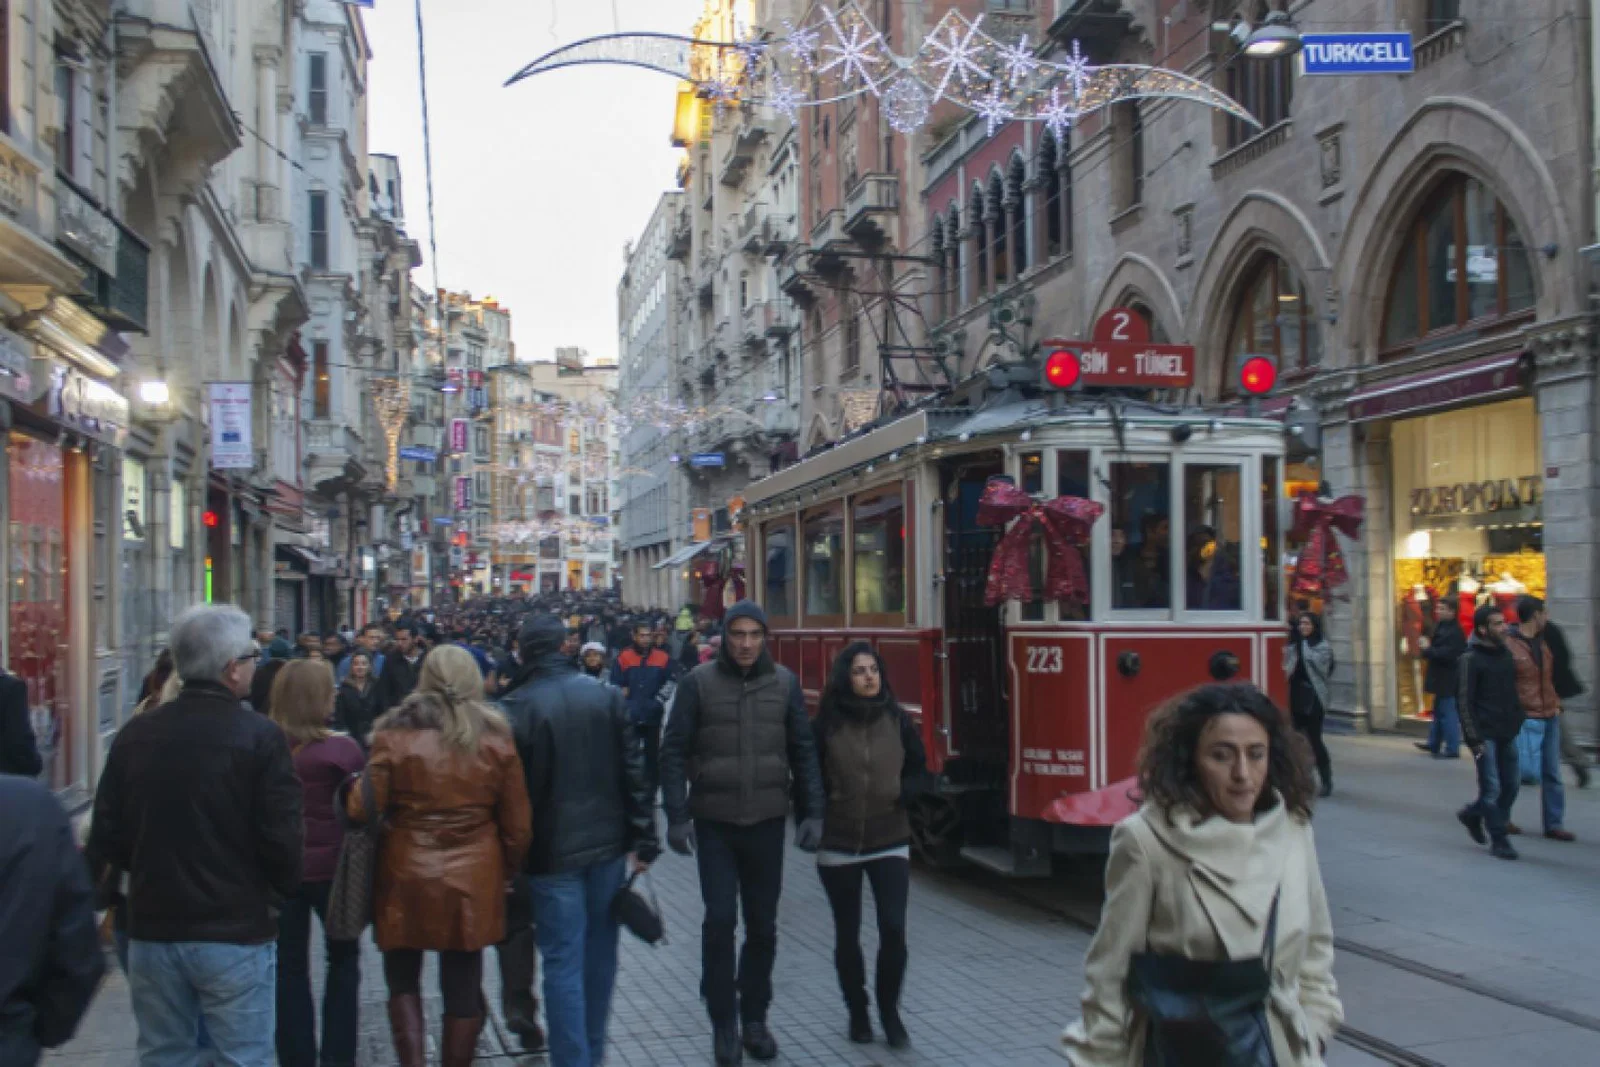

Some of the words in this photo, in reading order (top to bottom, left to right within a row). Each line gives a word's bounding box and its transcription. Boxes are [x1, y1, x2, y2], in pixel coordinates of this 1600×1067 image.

[1305, 42, 1410, 63] TURKCELL
[1111, 312, 1129, 340] 2
[1026, 646, 1063, 673] 223
